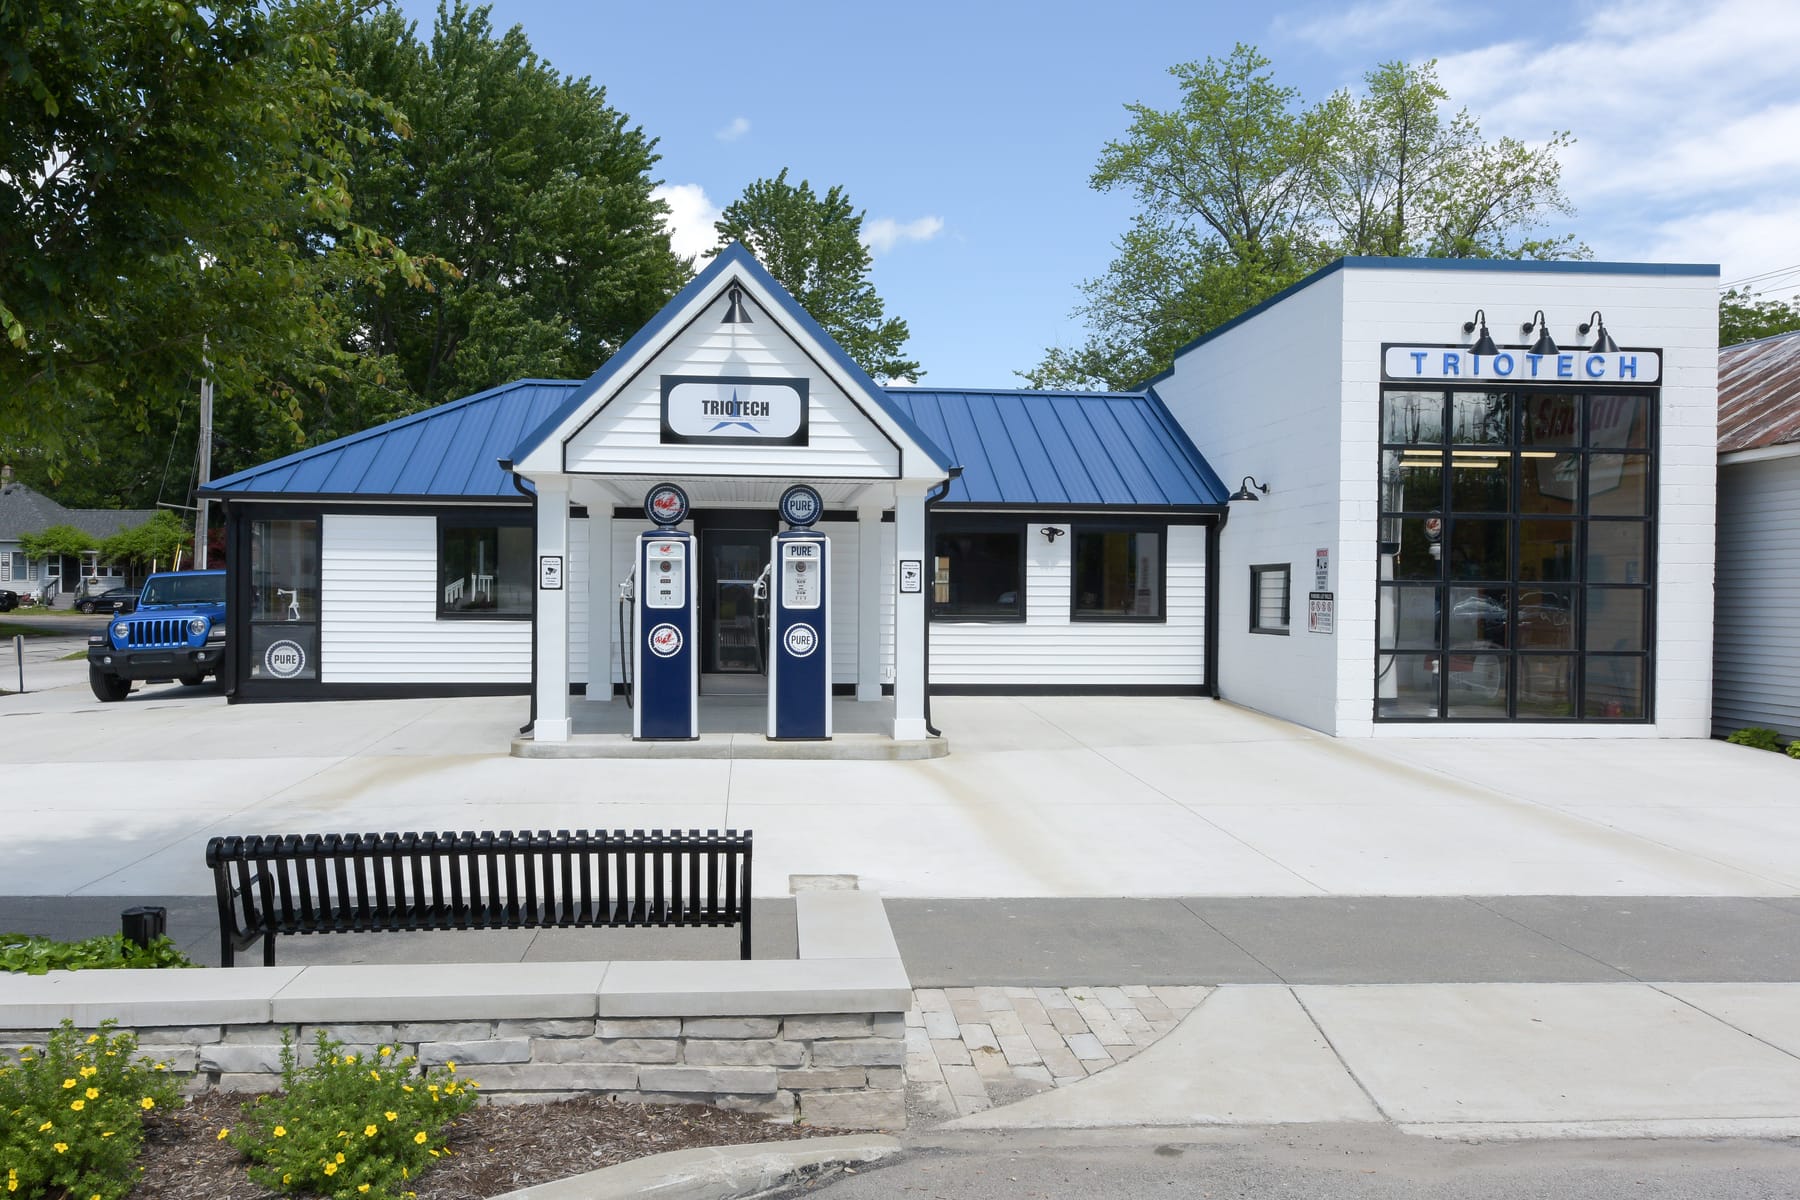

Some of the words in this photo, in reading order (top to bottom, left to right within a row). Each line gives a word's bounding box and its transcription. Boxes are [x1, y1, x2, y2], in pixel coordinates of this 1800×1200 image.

[1410, 351, 1637, 378] TRIOTECH
[701, 400, 770, 416] TRIOTECH
[1535, 397, 1627, 439] Sinair
[790, 500, 812, 511] PURE
[791, 546, 812, 556] PURE
[791, 635, 811, 645] PURE
[274, 654, 297, 665] PURE
